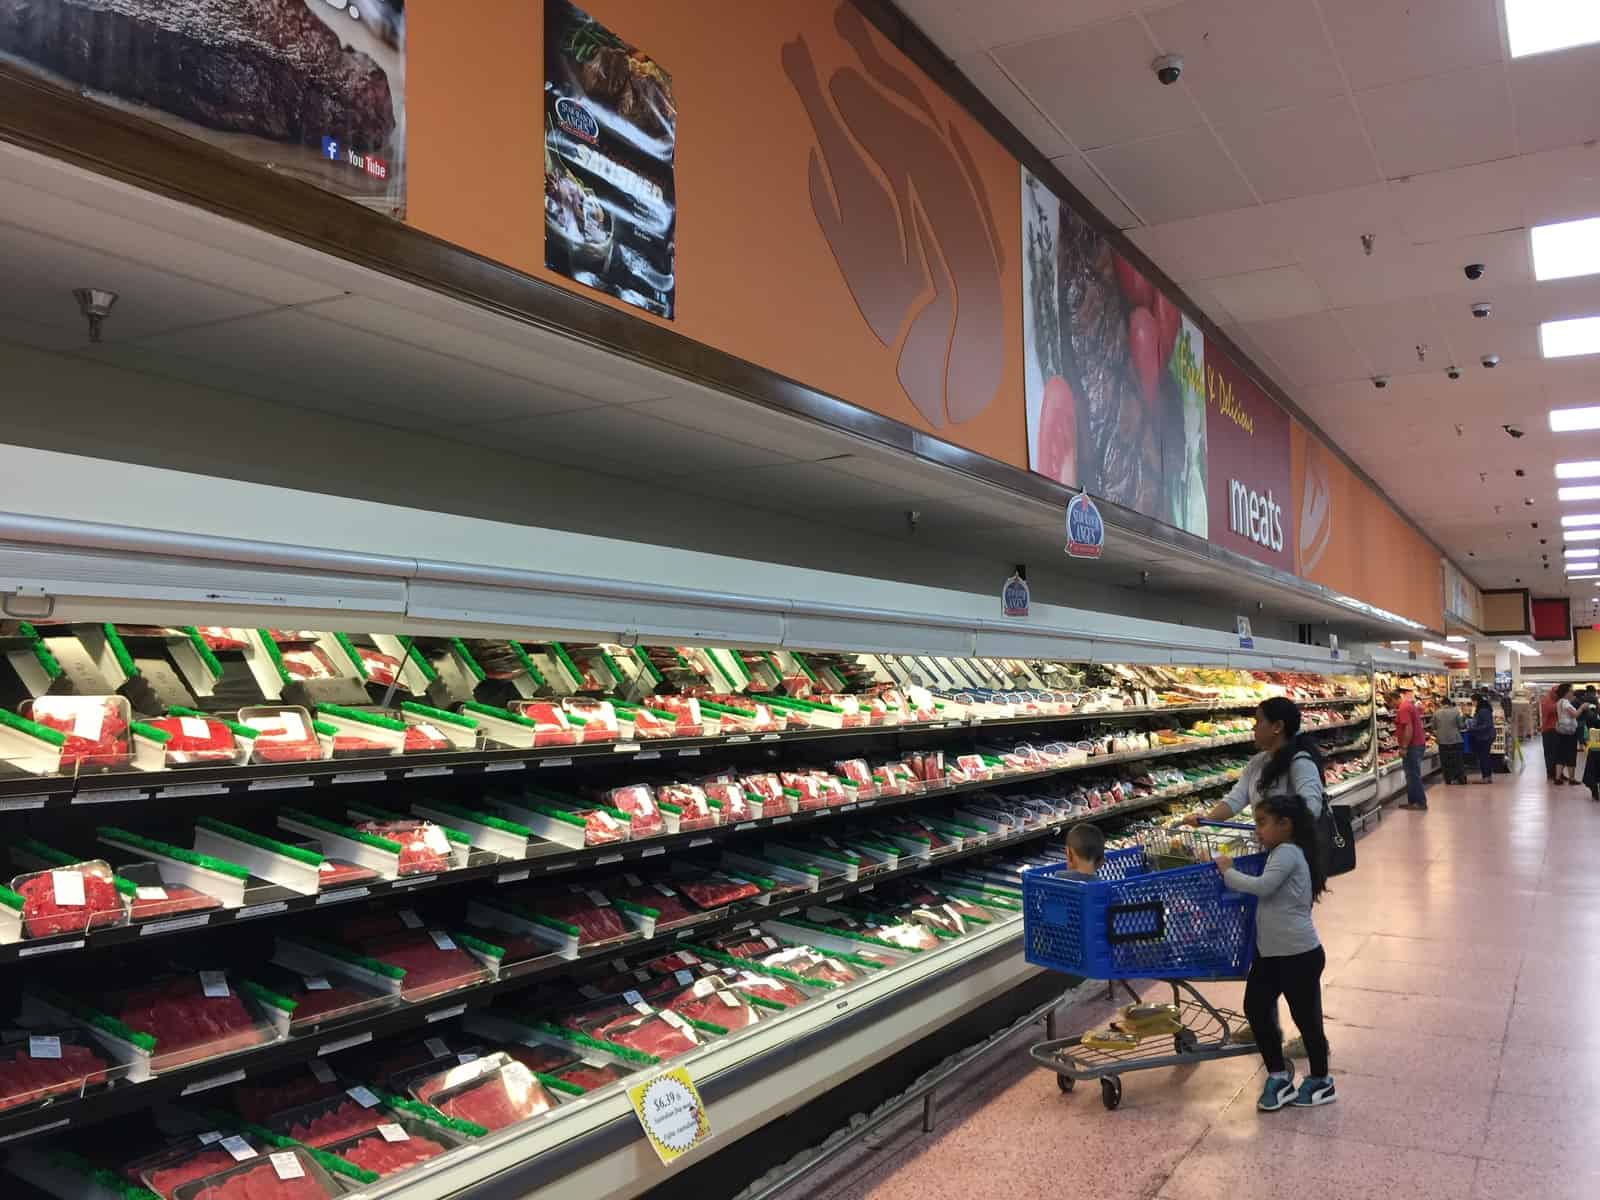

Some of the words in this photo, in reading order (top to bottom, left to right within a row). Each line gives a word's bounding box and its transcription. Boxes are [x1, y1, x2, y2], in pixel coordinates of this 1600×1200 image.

[348, 148, 364, 168] You
[365, 156, 386, 178] Tube
[1218, 372, 1254, 437] Delicious
[1230, 478, 1283, 552] meats
[653, 1092, 676, 1112] $6.39
